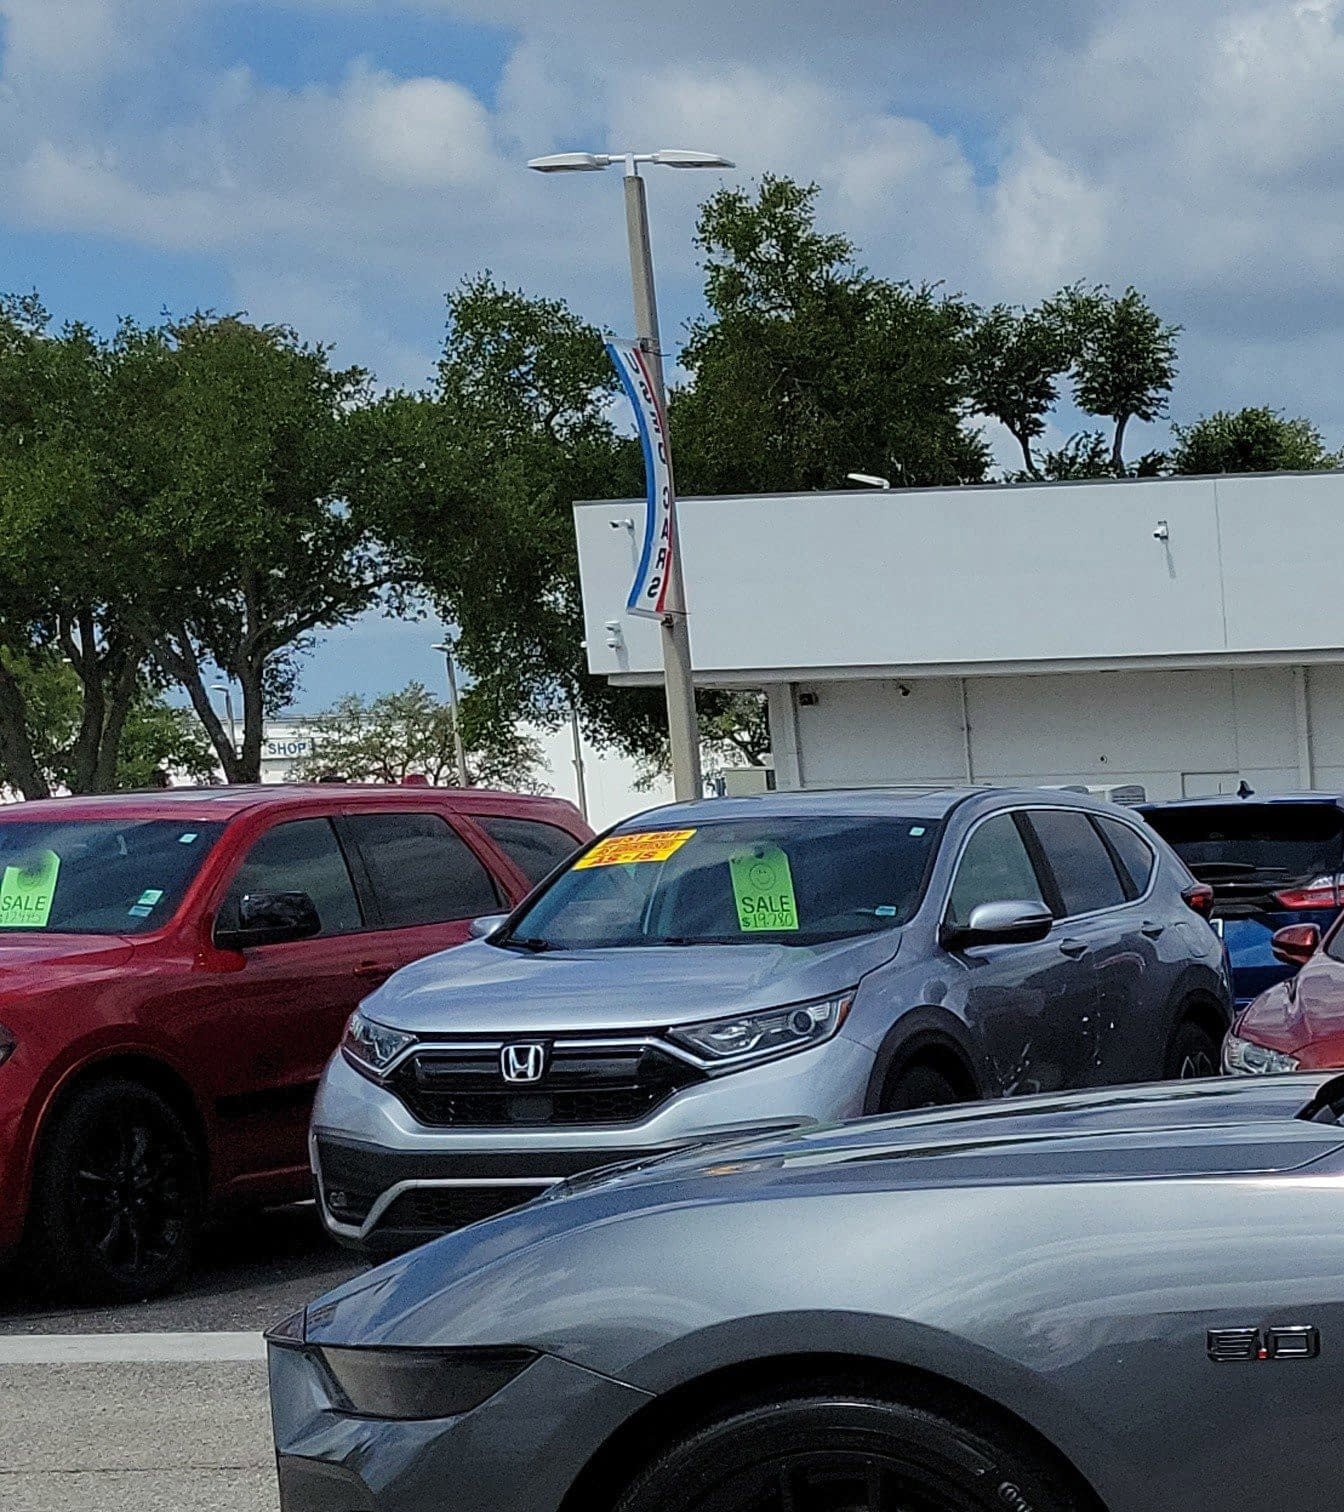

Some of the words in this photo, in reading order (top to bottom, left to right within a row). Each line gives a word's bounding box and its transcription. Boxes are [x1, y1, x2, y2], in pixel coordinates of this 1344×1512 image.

[268, 742, 307, 755] SHOP
[2, 895, 47, 911] SALE
[742, 896, 790, 914] SALE
[1207, 1325, 1320, 1362] 5.0
